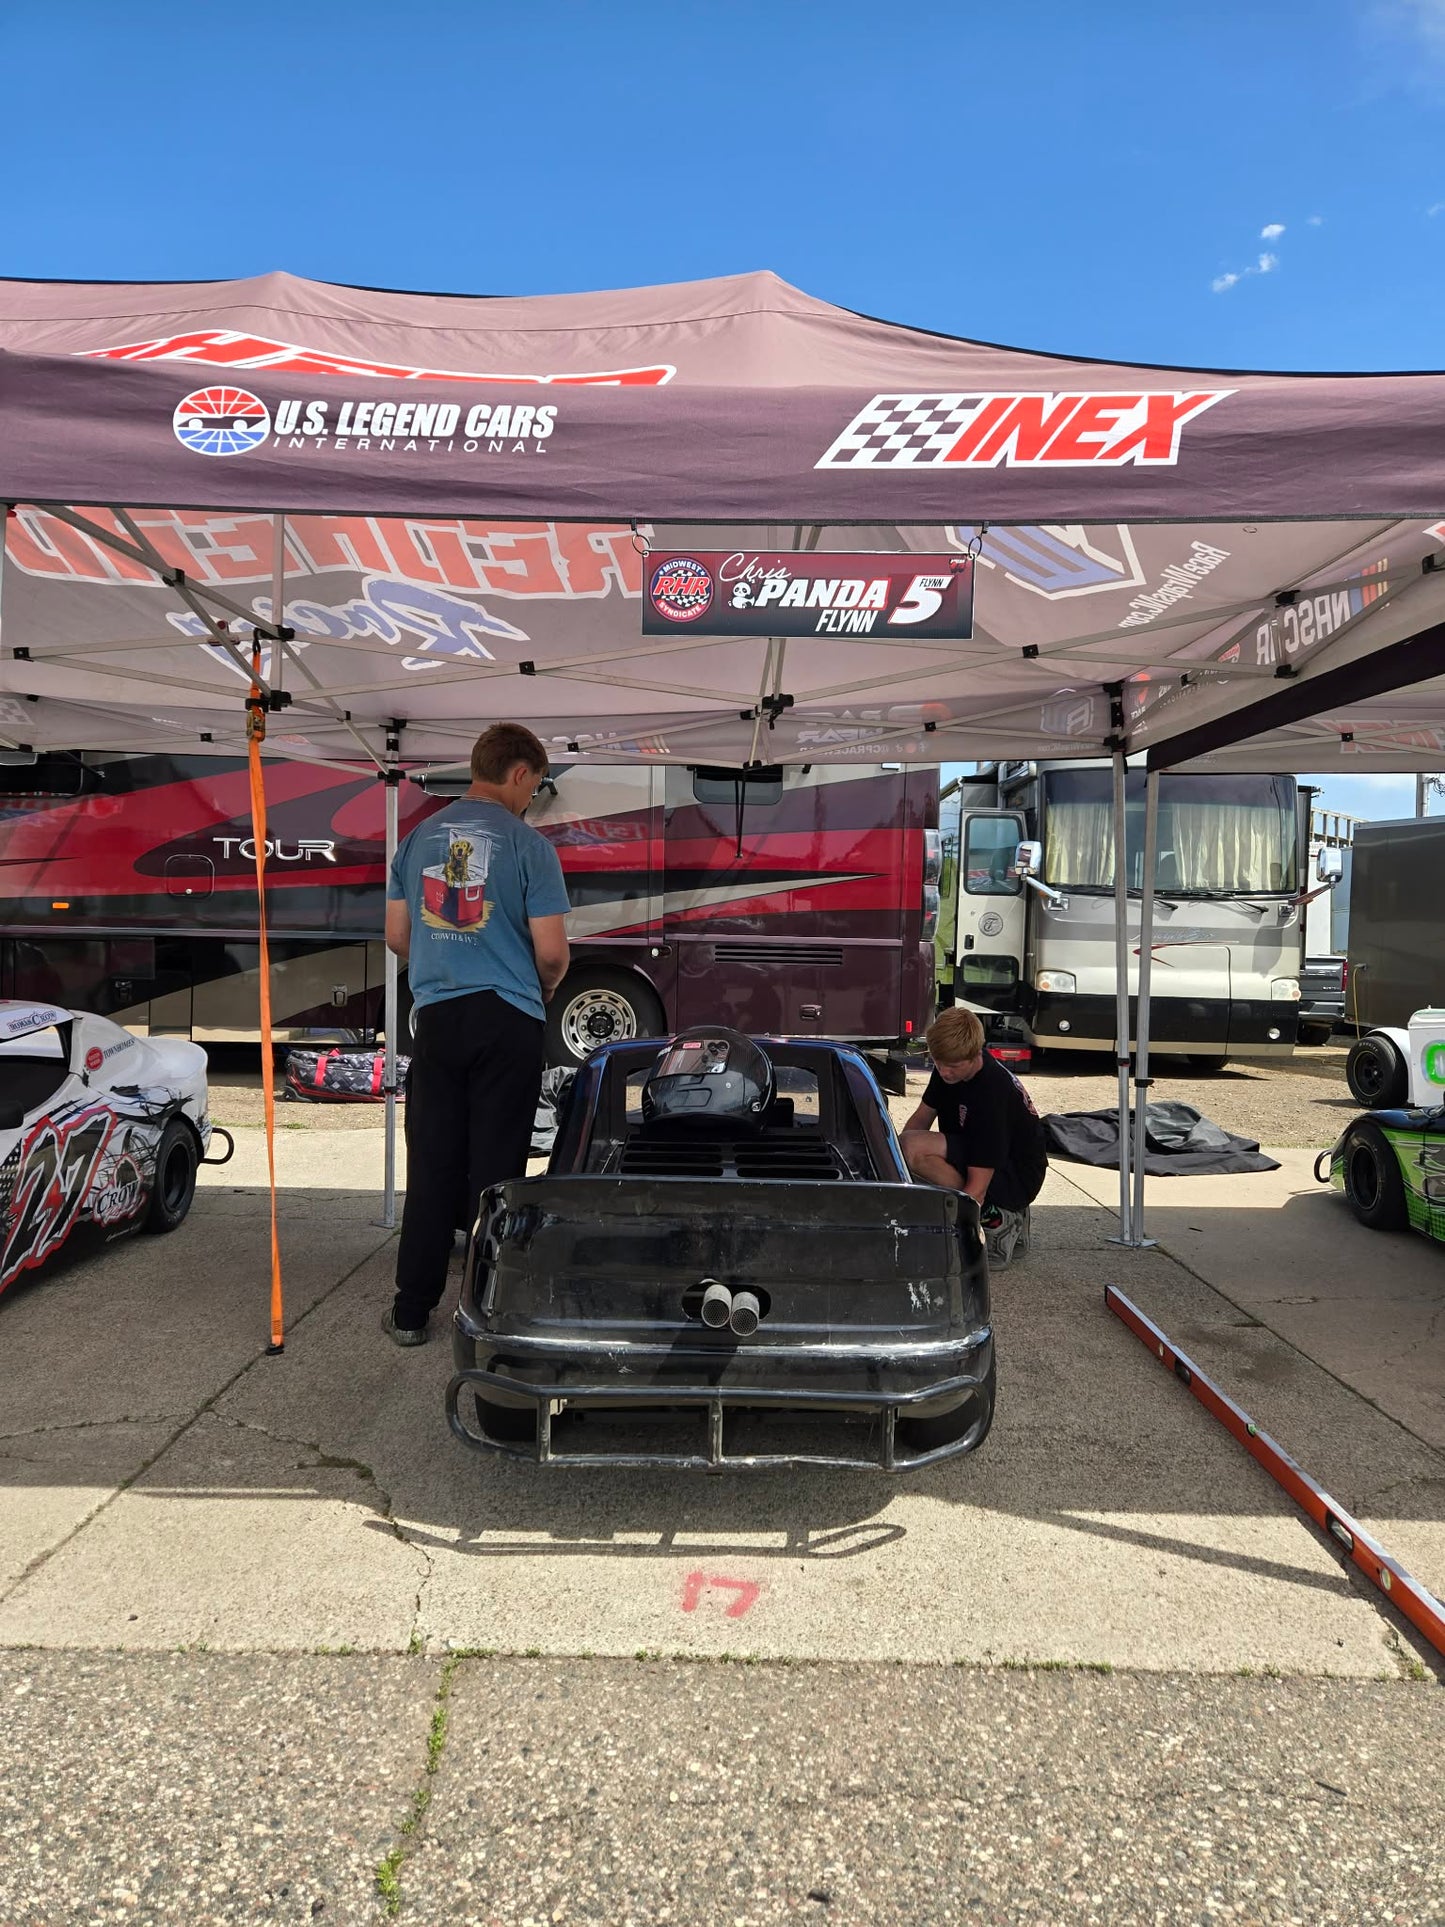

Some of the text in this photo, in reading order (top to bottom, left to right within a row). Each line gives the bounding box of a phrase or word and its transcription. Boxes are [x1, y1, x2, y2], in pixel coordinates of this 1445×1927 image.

[274, 401, 558, 439] U.S. LEGEND CARS
[938, 390, 1240, 466] INEX
[273, 437, 547, 454] INTERNATIONAL
[662, 560, 702, 573] MIDWEST
[719, 553, 791, 582] Chris
[653, 576, 710, 595] RHR
[919, 578, 944, 588] FLYNN
[658, 602, 702, 618] SYNDICATE
[754, 575, 955, 624] PANDA 5
[815, 610, 879, 633] FLYNN
[212, 837, 336, 862] TOUR
[97, 1181, 139, 1214] CROW
